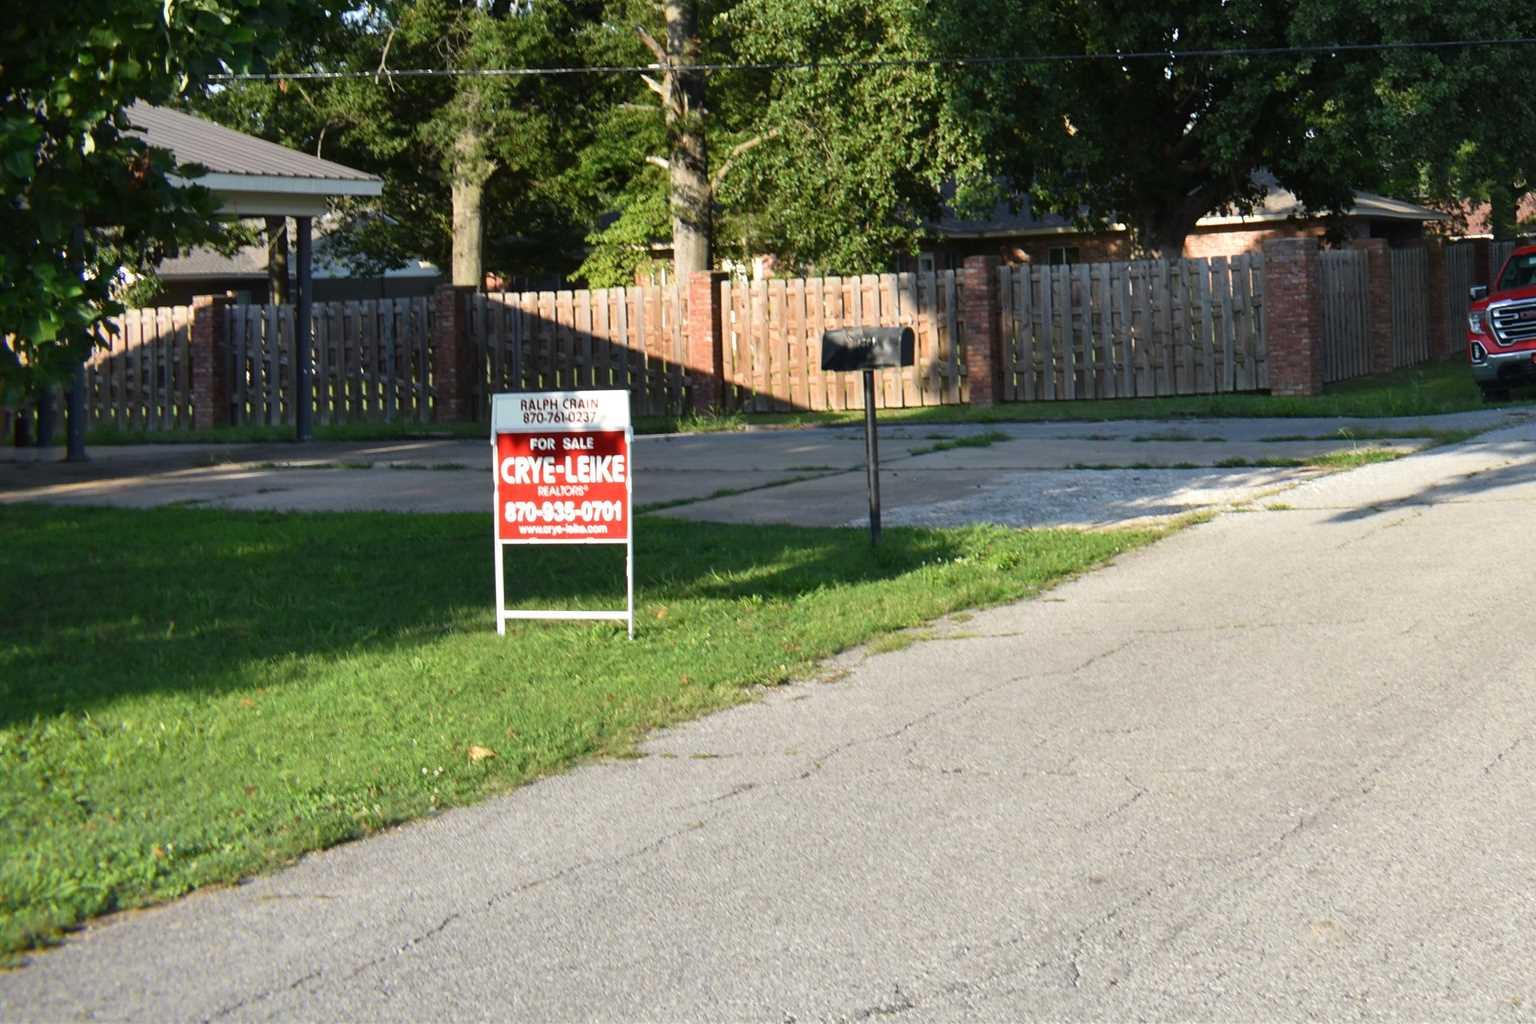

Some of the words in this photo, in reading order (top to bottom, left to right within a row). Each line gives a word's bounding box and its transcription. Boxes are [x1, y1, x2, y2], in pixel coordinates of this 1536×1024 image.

[520, 398, 558, 410] RALPH
[562, 397, 599, 410] CRAIN
[523, 411, 596, 423] 870-761-0237
[530, 438, 555, 450] FOR
[563, 437, 594, 449] SALE
[501, 455, 624, 483] CRYE-LEIKE
[505, 501, 621, 522] 870-935-0701
